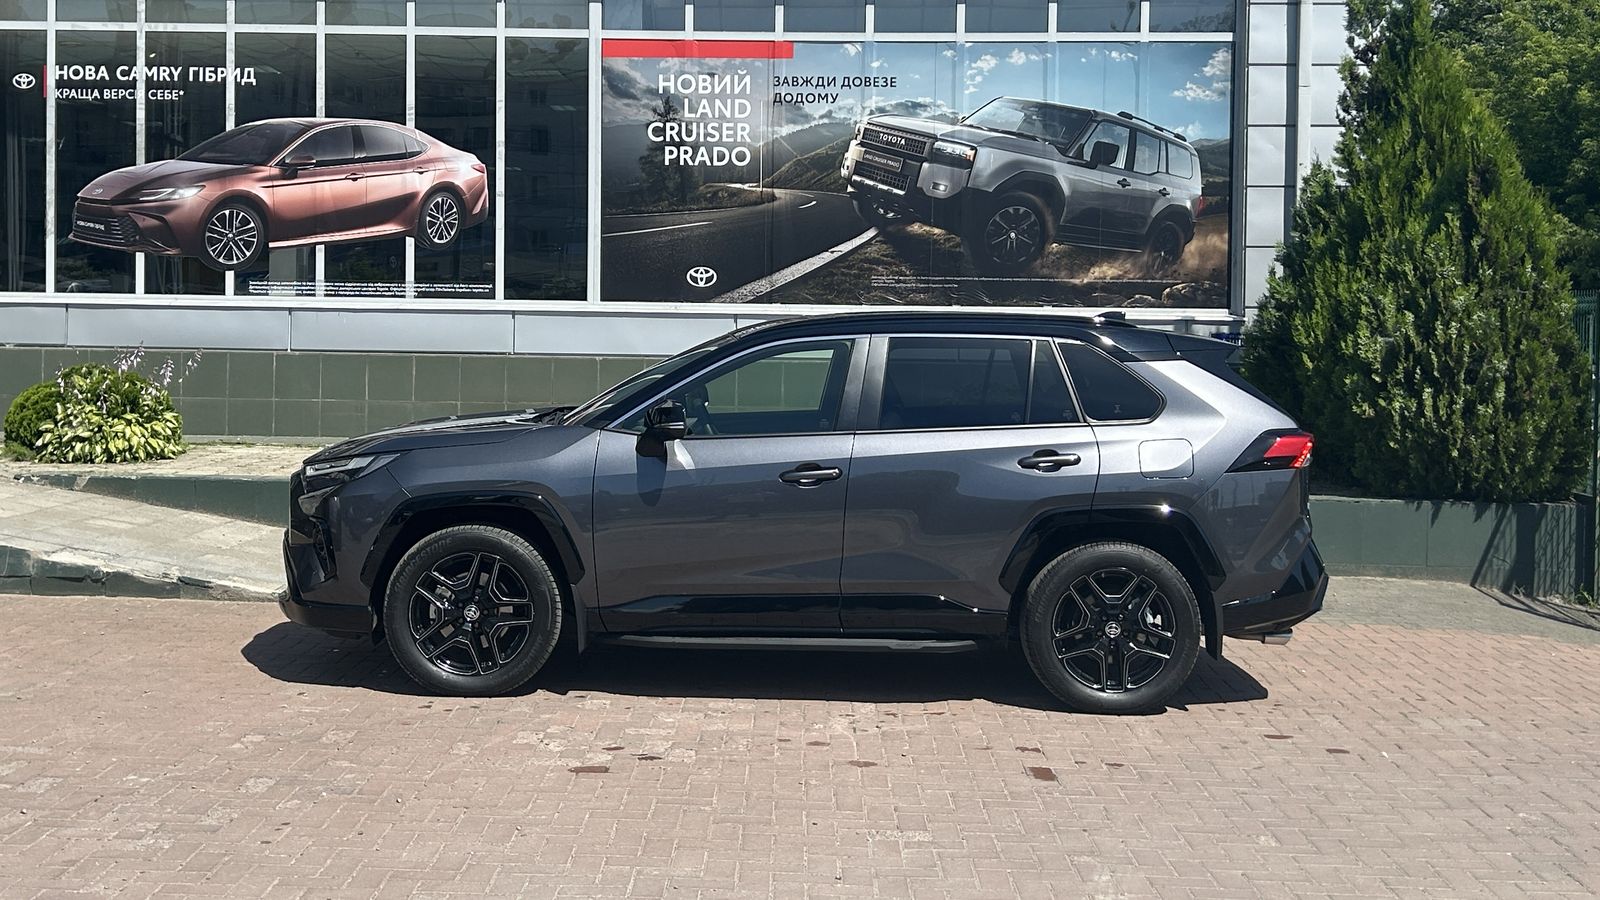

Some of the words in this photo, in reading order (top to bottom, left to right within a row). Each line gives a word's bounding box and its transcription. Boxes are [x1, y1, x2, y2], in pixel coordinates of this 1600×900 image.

[55, 65, 110, 80] НОВА
[116, 65, 182, 81] CAMRY
[188, 66, 257, 86] ГІБРИД
[658, 69, 751, 95] НОВИЙ
[773, 75, 837, 90] ЗАВЖДИ
[840, 76, 897, 90] ДОВЕЗЕ
[55, 88, 101, 101] КРАЩА
[772, 92, 839, 106] ДОДОМУ
[684, 98, 752, 118] LAND
[647, 121, 752, 142] CRUISER
[880, 133, 905, 145] TOYOTA
[664, 146, 752, 167] PRADO
